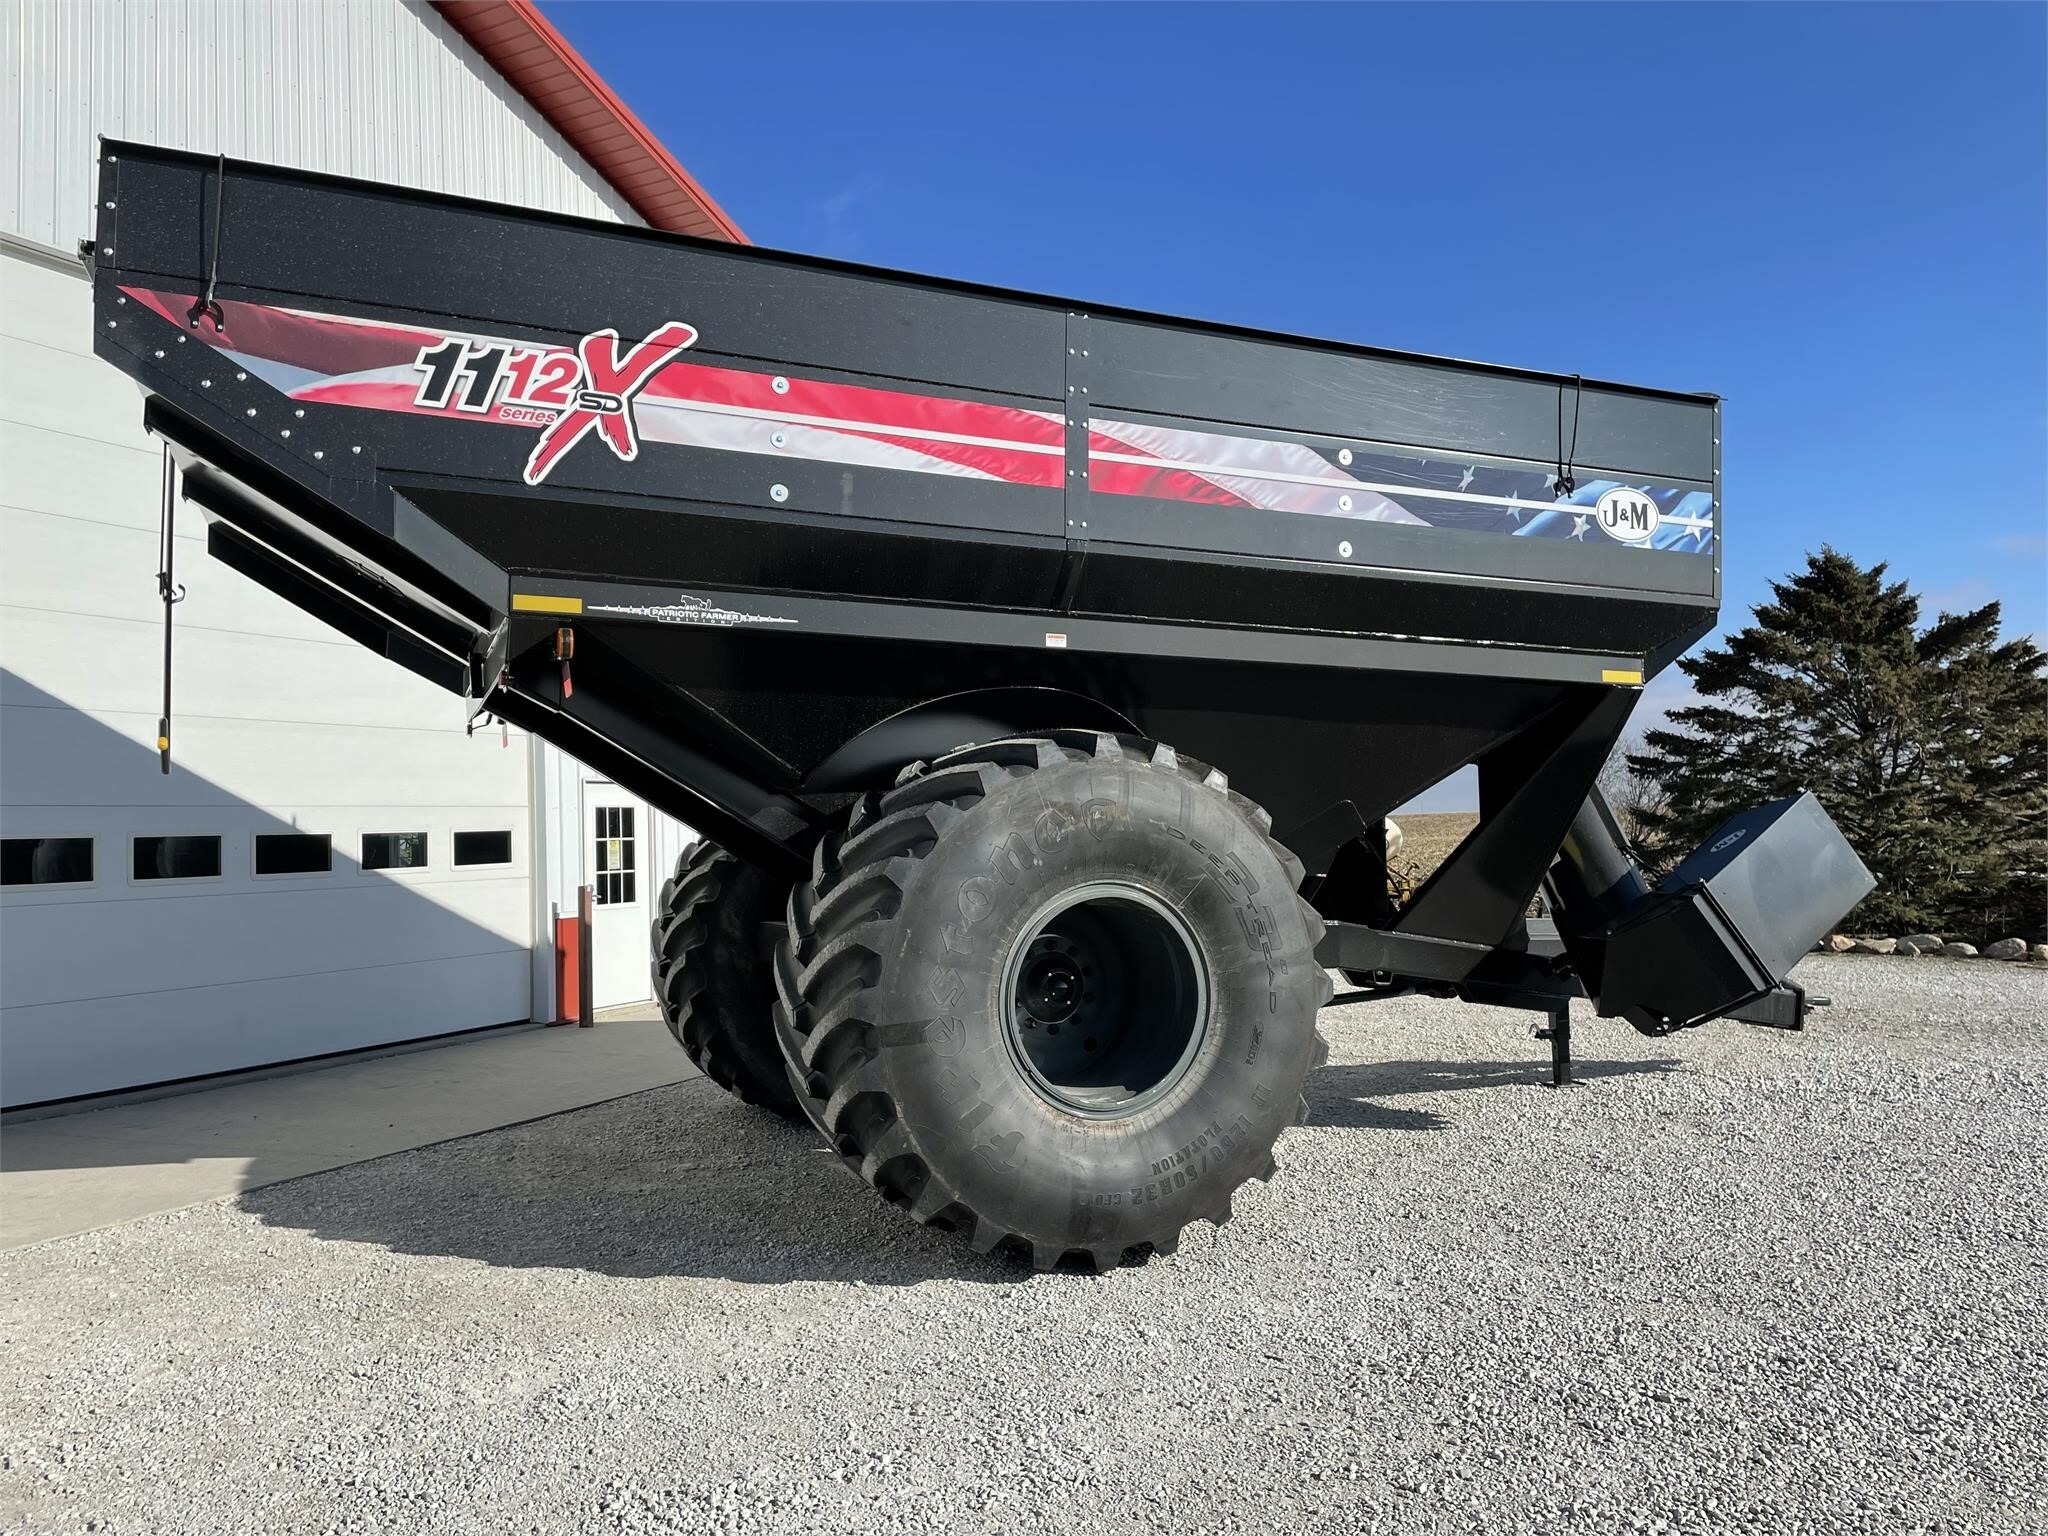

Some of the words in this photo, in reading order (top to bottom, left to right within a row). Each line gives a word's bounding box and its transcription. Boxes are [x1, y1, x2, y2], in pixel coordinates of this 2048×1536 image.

[499, 405, 557, 424] series
[1603, 499, 1649, 531] J&M
[652, 608, 700, 619] PATRIOTIC
[701, 612, 739, 621] FARMER
[666, 616, 726, 625] EDITION
[1167, 826, 1240, 885] DEEP
[1246, 895, 1277, 1014] TREAD
[924, 808, 1069, 1173] Firestone
